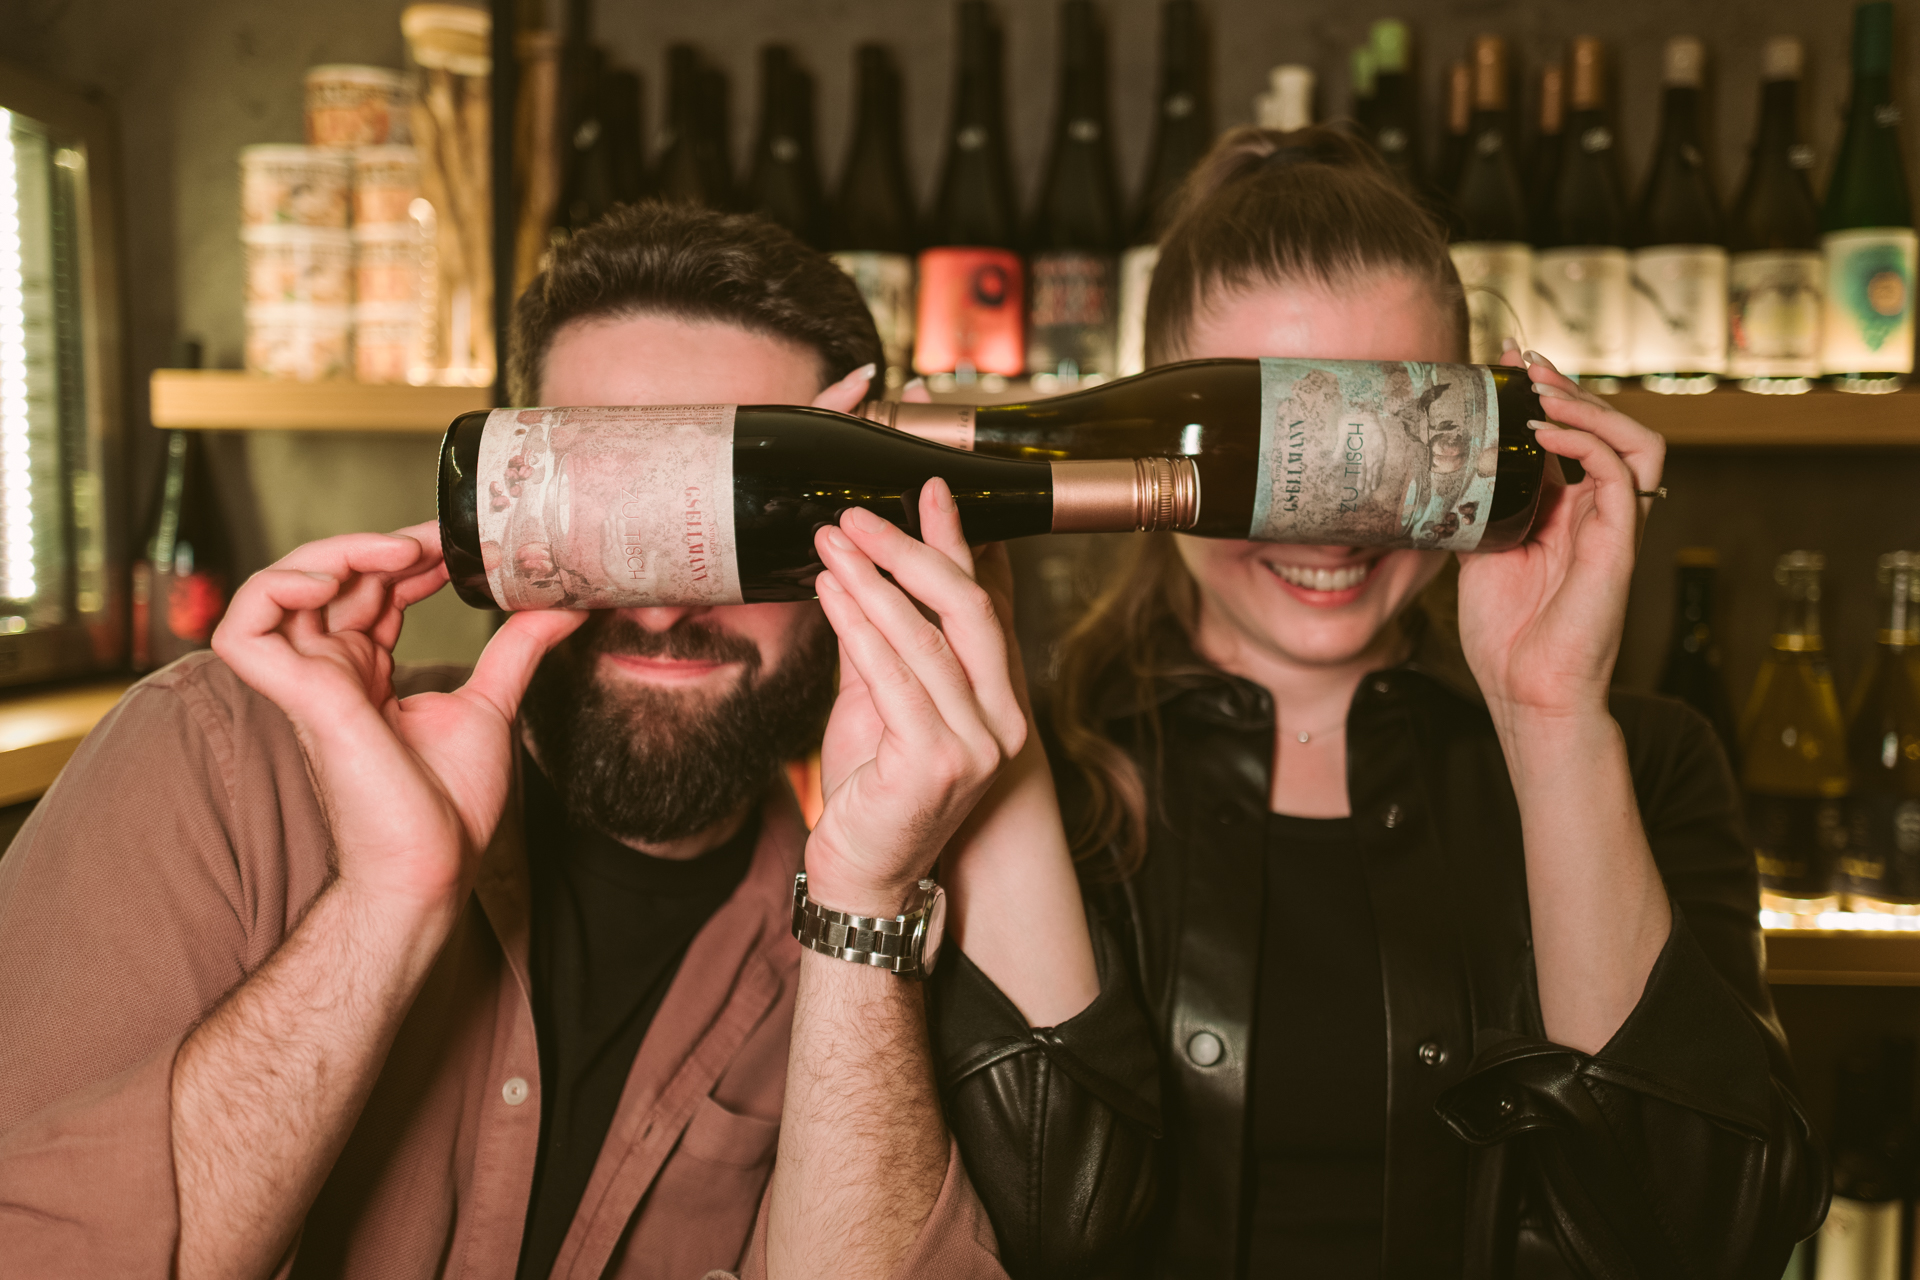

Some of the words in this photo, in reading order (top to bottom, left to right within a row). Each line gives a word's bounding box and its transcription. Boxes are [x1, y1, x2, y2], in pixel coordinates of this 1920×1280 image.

[1282, 419, 1305, 512] GSELLMANN
[1344, 423, 1364, 478] TISCH
[621, 487, 639, 520] ZU
[1339, 487, 1359, 513] ZU
[623, 530, 646, 580] TISCH
[685, 486, 708, 582] GSELLMANN
[708, 522, 716, 555] ANDREAS
